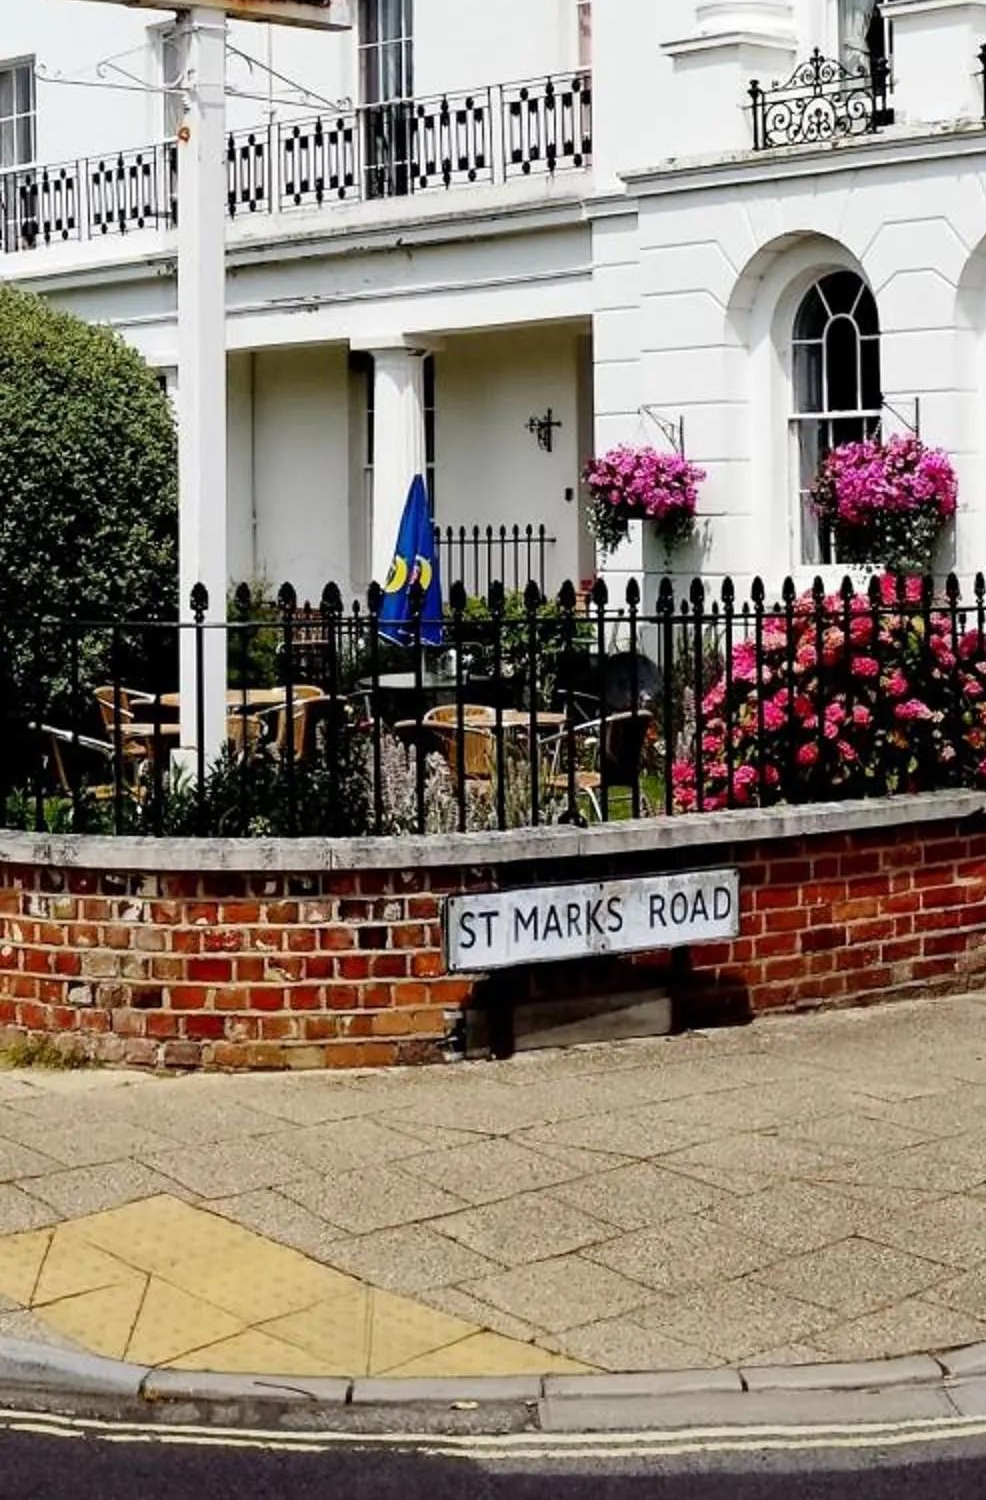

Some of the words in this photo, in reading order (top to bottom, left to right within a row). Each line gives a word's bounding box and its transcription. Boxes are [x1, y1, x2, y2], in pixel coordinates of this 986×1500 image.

[459, 911, 499, 949] ST
[514, 896, 623, 943] MARKS
[649, 887, 732, 929] ROAD
